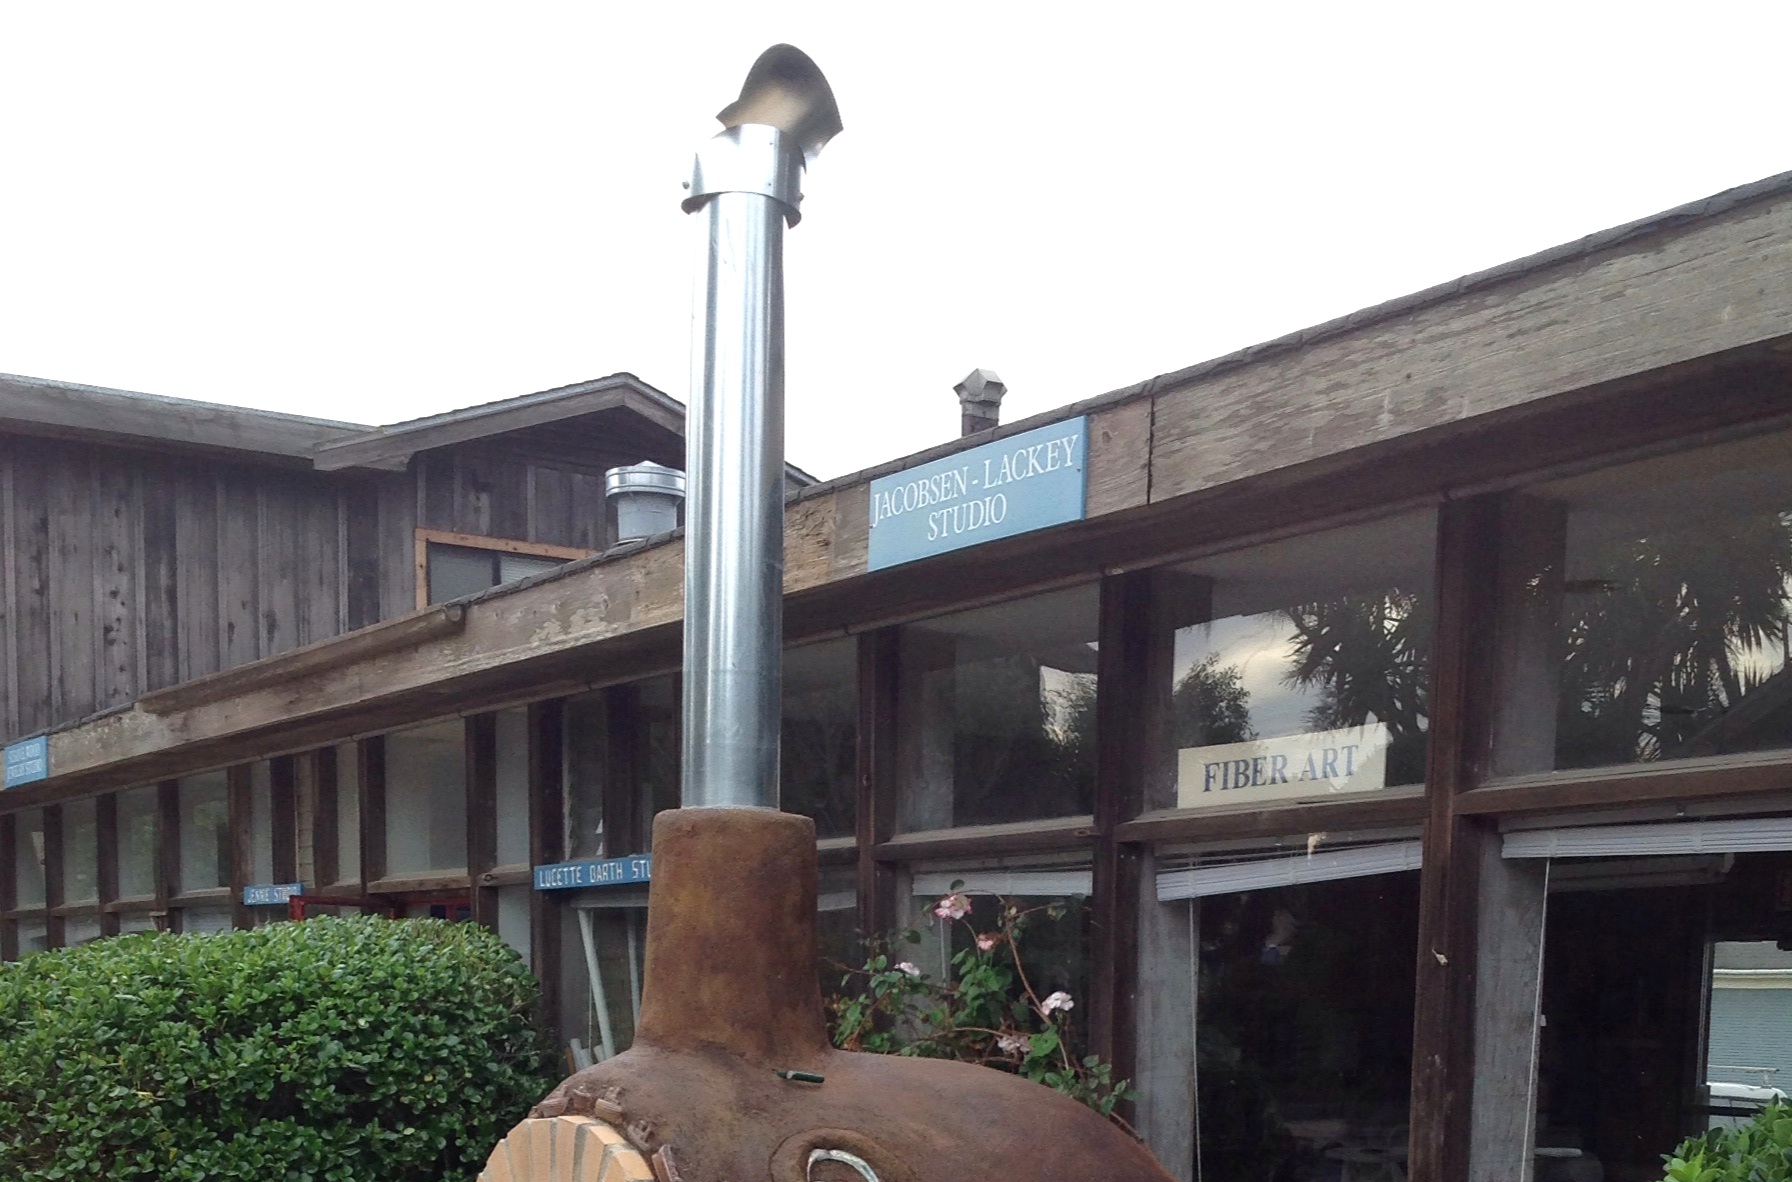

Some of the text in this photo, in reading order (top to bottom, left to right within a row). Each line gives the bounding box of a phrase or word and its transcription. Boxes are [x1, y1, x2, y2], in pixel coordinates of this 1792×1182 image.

[871, 466, 969, 528] JACOBSEN
[982, 434, 1079, 489] LACKEY
[927, 493, 1008, 541] STUDIO
[1202, 744, 1359, 793] FIBER ART
[539, 865, 583, 888] LUCETTE
